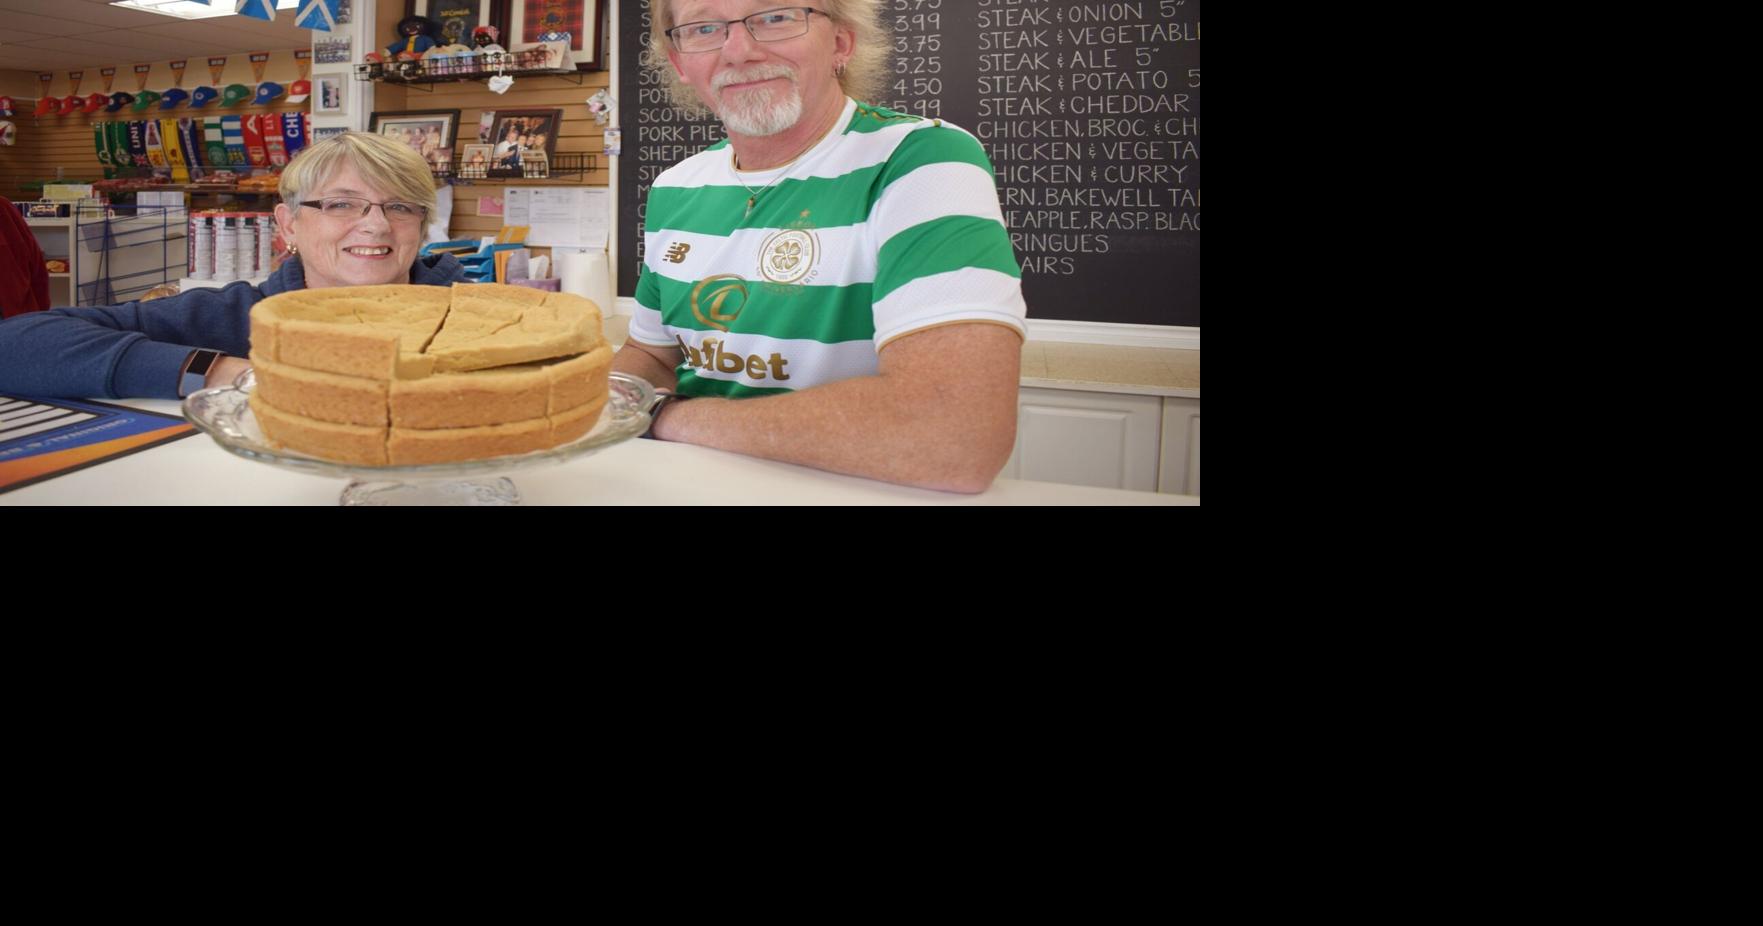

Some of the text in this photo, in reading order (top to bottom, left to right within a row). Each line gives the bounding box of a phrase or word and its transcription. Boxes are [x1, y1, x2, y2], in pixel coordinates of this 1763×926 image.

[894, 12, 941, 32] 3.99
[978, 8, 1052, 28] STEAK
[1056, 8, 1063, 22] &
[1068, 3, 1142, 22] ONION
[894, 34, 942, 53] 3.75
[978, 30, 1049, 50] STEAK
[1056, 30, 1063, 45] &
[895, 56, 942, 74] 3.25
[978, 52, 1051, 72] STEAK
[1057, 53, 1064, 68] &
[1070, 48, 1118, 69] ALE
[893, 78, 943, 96] 4.50
[977, 75, 1053, 95] STEAK
[1057, 75, 1064, 91] &
[1073, 69, 1168, 91] POTATO
[894, 99, 941, 118] 5.99
[978, 93, 1190, 117] STEAK & CHEDDAR
[264, 113, 275, 131] LIV
[284, 112, 300, 138] CHE
[639, 107, 708, 124] SCOTCH
[639, 126, 685, 142] PORK
[1153, 119, 1161, 136] &
[1165, 117, 1200, 136] CH
[1088, 142, 1097, 159] &
[1101, 140, 1200, 160] VEGETA
[993, 164, 1189, 184] HICKEN & CURRY
[1045, 188, 1161, 207] BAKEWELL
[1155, 211, 1200, 231] BLAC
[1010, 232, 1110, 253] RINGUES
[1021, 256, 1075, 275] AIRS
